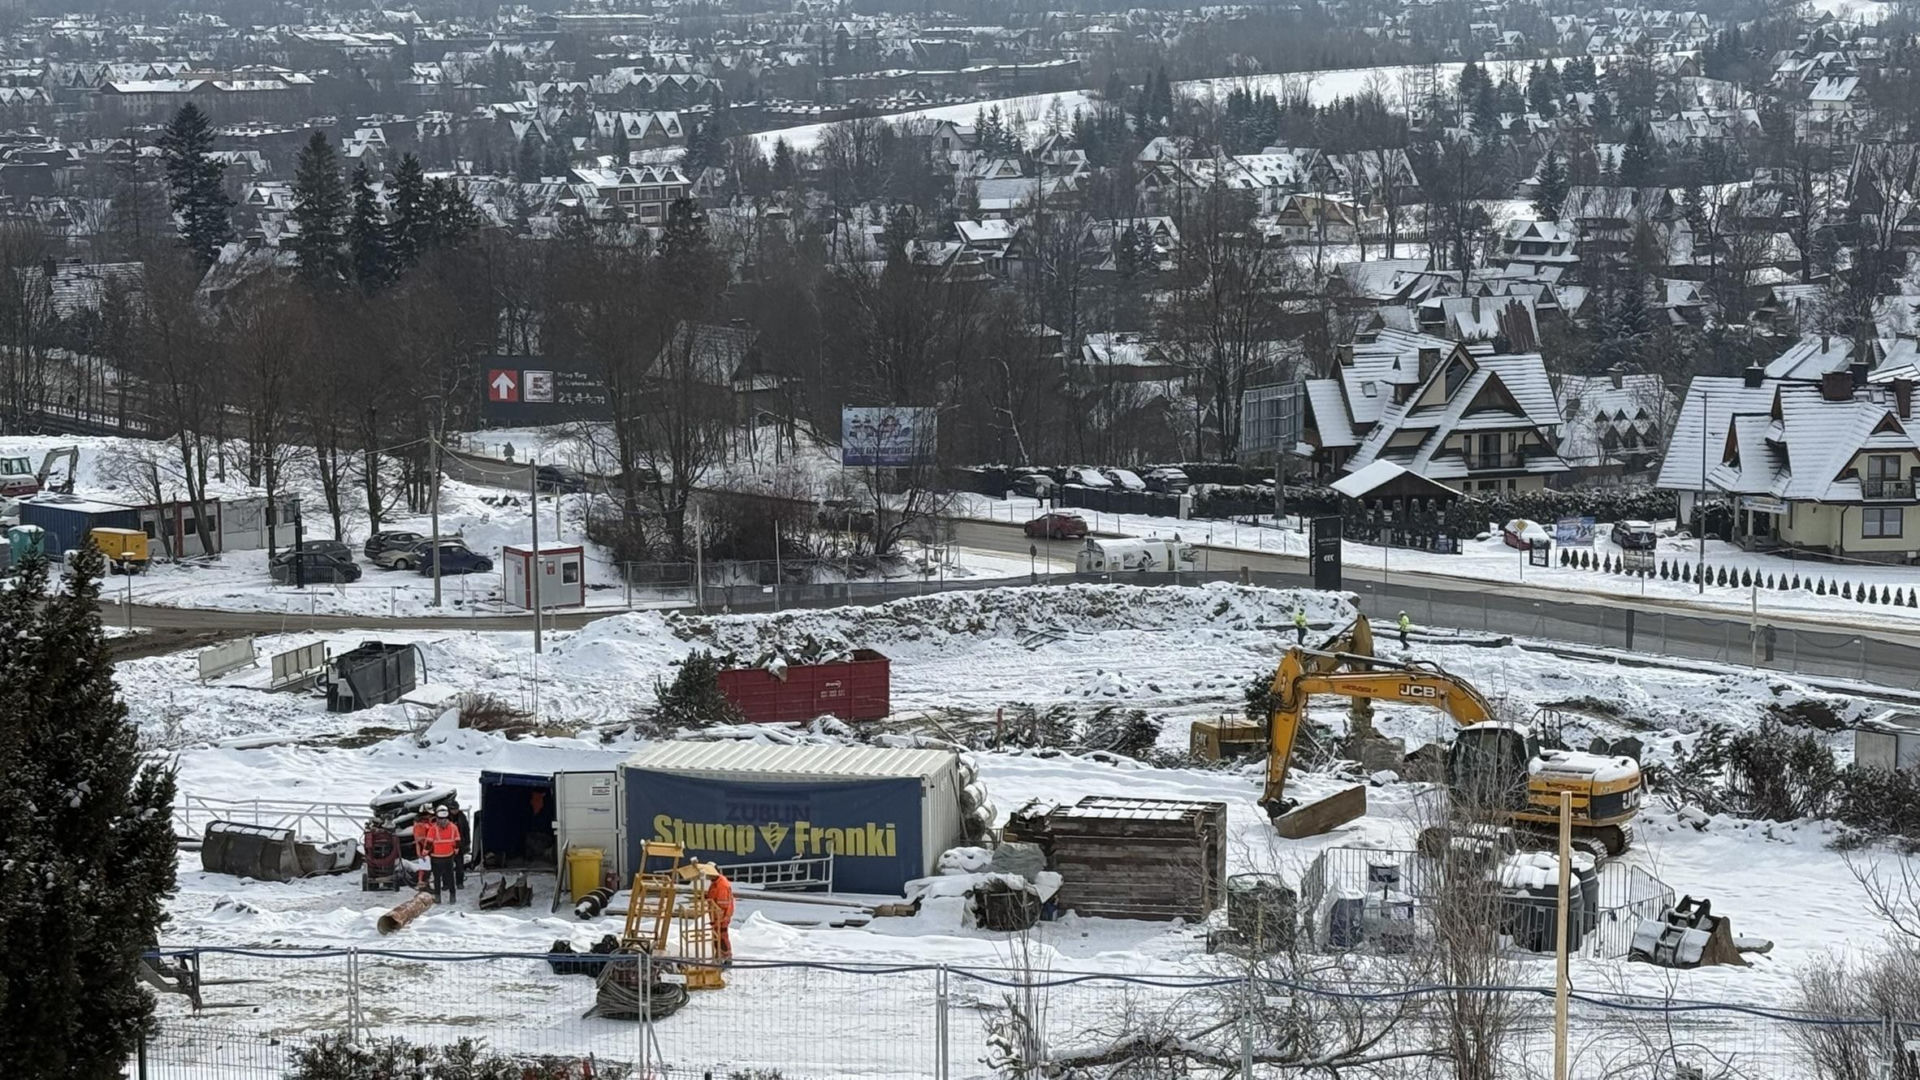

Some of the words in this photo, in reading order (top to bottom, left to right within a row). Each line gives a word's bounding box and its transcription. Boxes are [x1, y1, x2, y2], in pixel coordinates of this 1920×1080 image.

[1400, 684, 1436, 697] JCB
[653, 814, 756, 856] Stump
[795, 821, 897, 857] Franki
